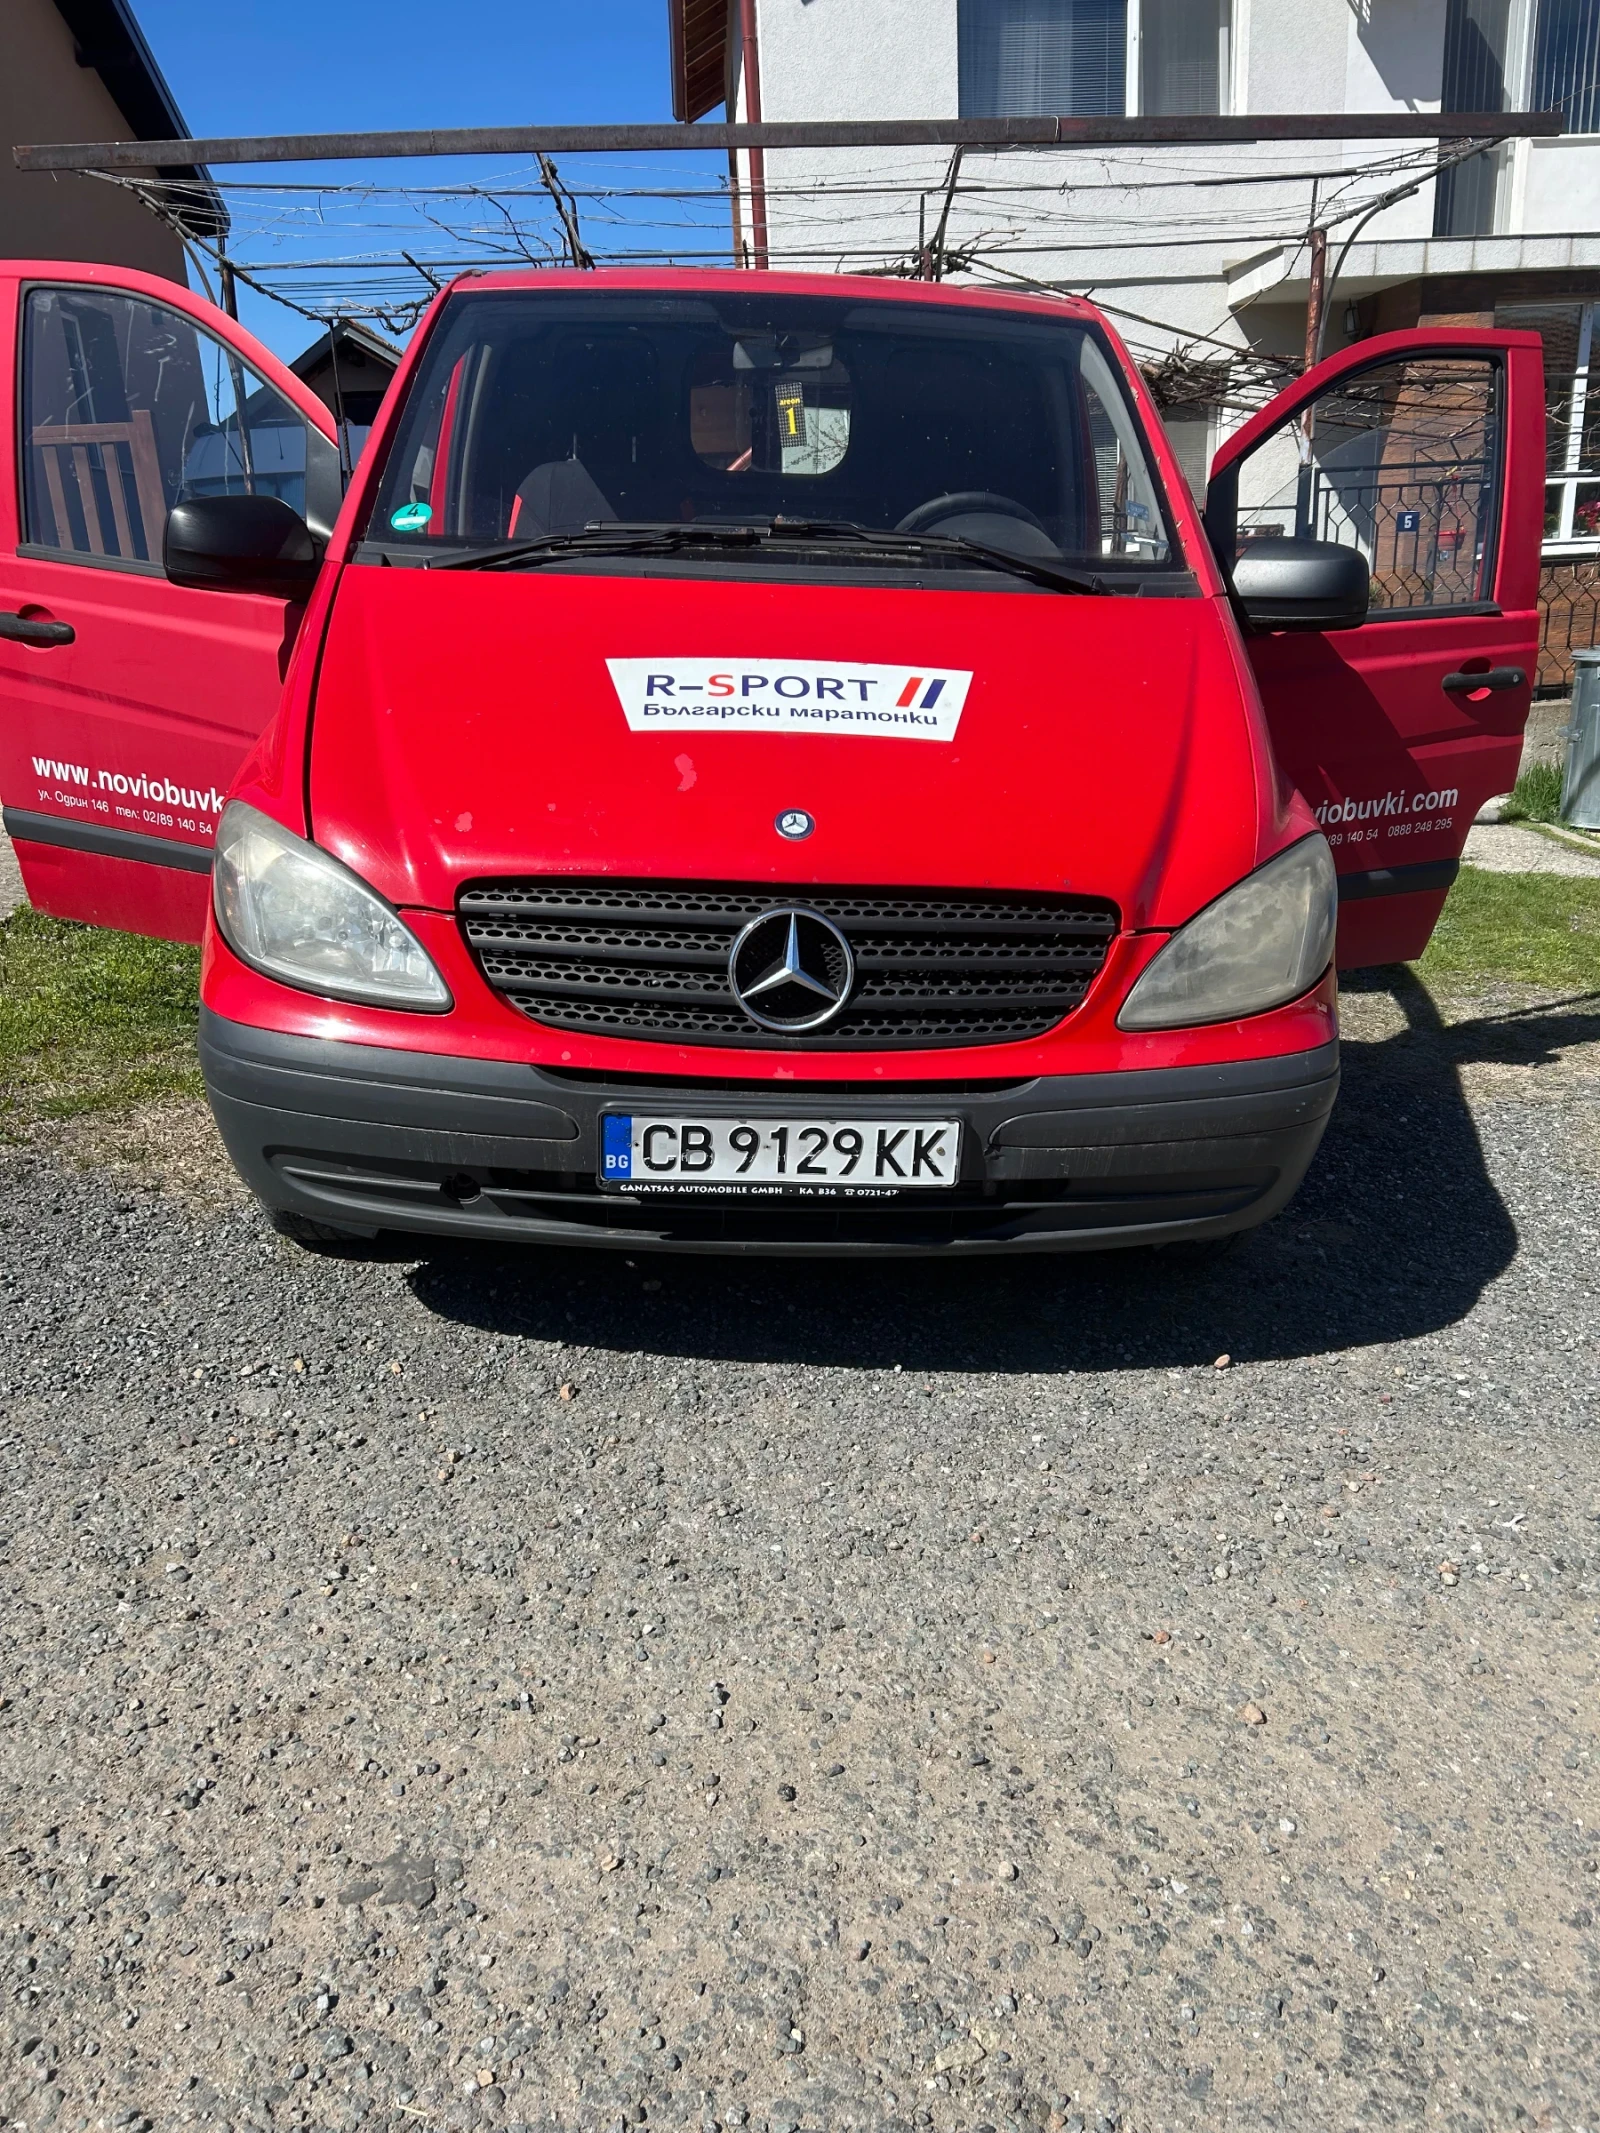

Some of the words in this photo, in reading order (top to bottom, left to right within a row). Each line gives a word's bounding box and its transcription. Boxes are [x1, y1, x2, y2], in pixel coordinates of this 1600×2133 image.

[779, 397, 801, 406] areon
[785, 407, 798, 435] 1
[407, 503, 419, 516] 4
[1404, 515, 1413, 529] 5
[645, 674, 878, 702] R-SPORT
[643, 703, 780, 720] Български
[789, 707, 938, 726] маратонки
[32, 756, 229, 814] www.noviobuvk
[37, 788, 53, 802] ул.
[91, 799, 110, 812] 146
[177, 817, 196, 832] 140
[199, 822, 214, 836] 54
[1347, 830, 1364, 843] 140
[1366, 828, 1379, 841] 54
[1387, 824, 1412, 838] 0888
[1414, 820, 1433, 834] 248
[1434, 817, 1453, 831] 295
[605, 1154, 629, 1170] BG
[620, 1184, 675, 1193] GANATSAS
[677, 1185, 748, 1194] AUTOMOBILE
[751, 1186, 783, 1195] GMBH
[799, 1187, 814, 1196] KA
[857, 1188, 900, 1197] 0721-47
